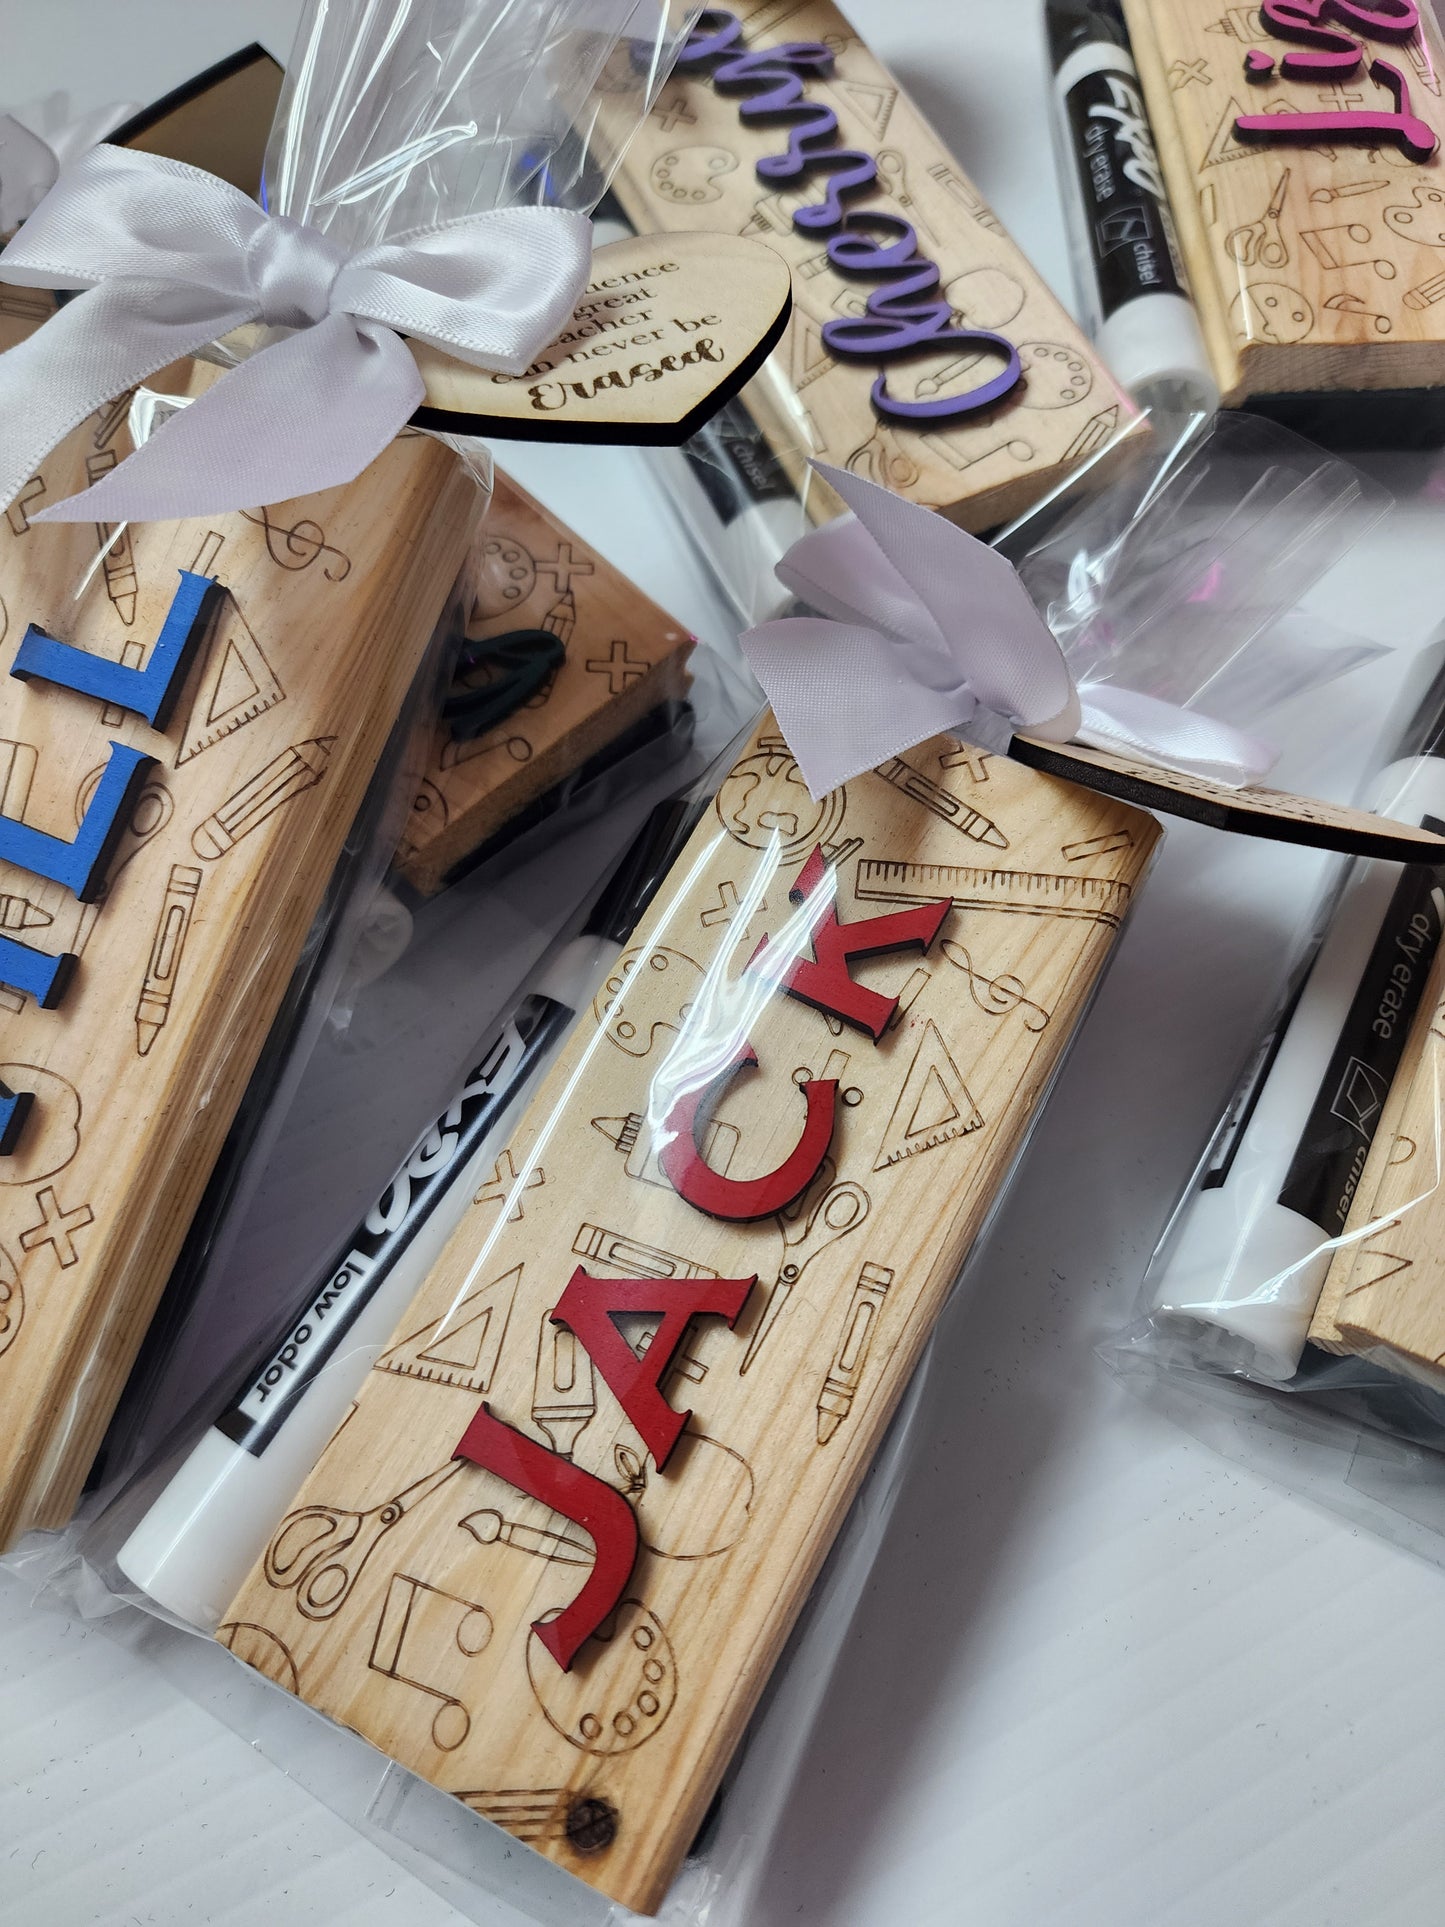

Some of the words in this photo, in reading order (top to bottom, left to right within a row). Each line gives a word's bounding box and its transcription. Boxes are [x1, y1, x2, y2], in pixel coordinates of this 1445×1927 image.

[1083, 122, 1110, 158] dry
[1090, 154, 1116, 203] erase
[585, 261, 680, 295] uence
[1132, 241, 1163, 286] chisel
[572, 287, 658, 321] great
[546, 309, 653, 350] acher
[566, 327, 666, 364] never
[671, 312, 723, 334] be
[527, 337, 725, 411] Erased
[732, 443, 777, 491] chisel
[1395, 912, 1432, 964] dry
[1372, 963, 1412, 1040] erase
[452, 843, 953, 1674] JACK
[314, 1260, 366, 1321] low
[257, 1322, 313, 1403] odor
